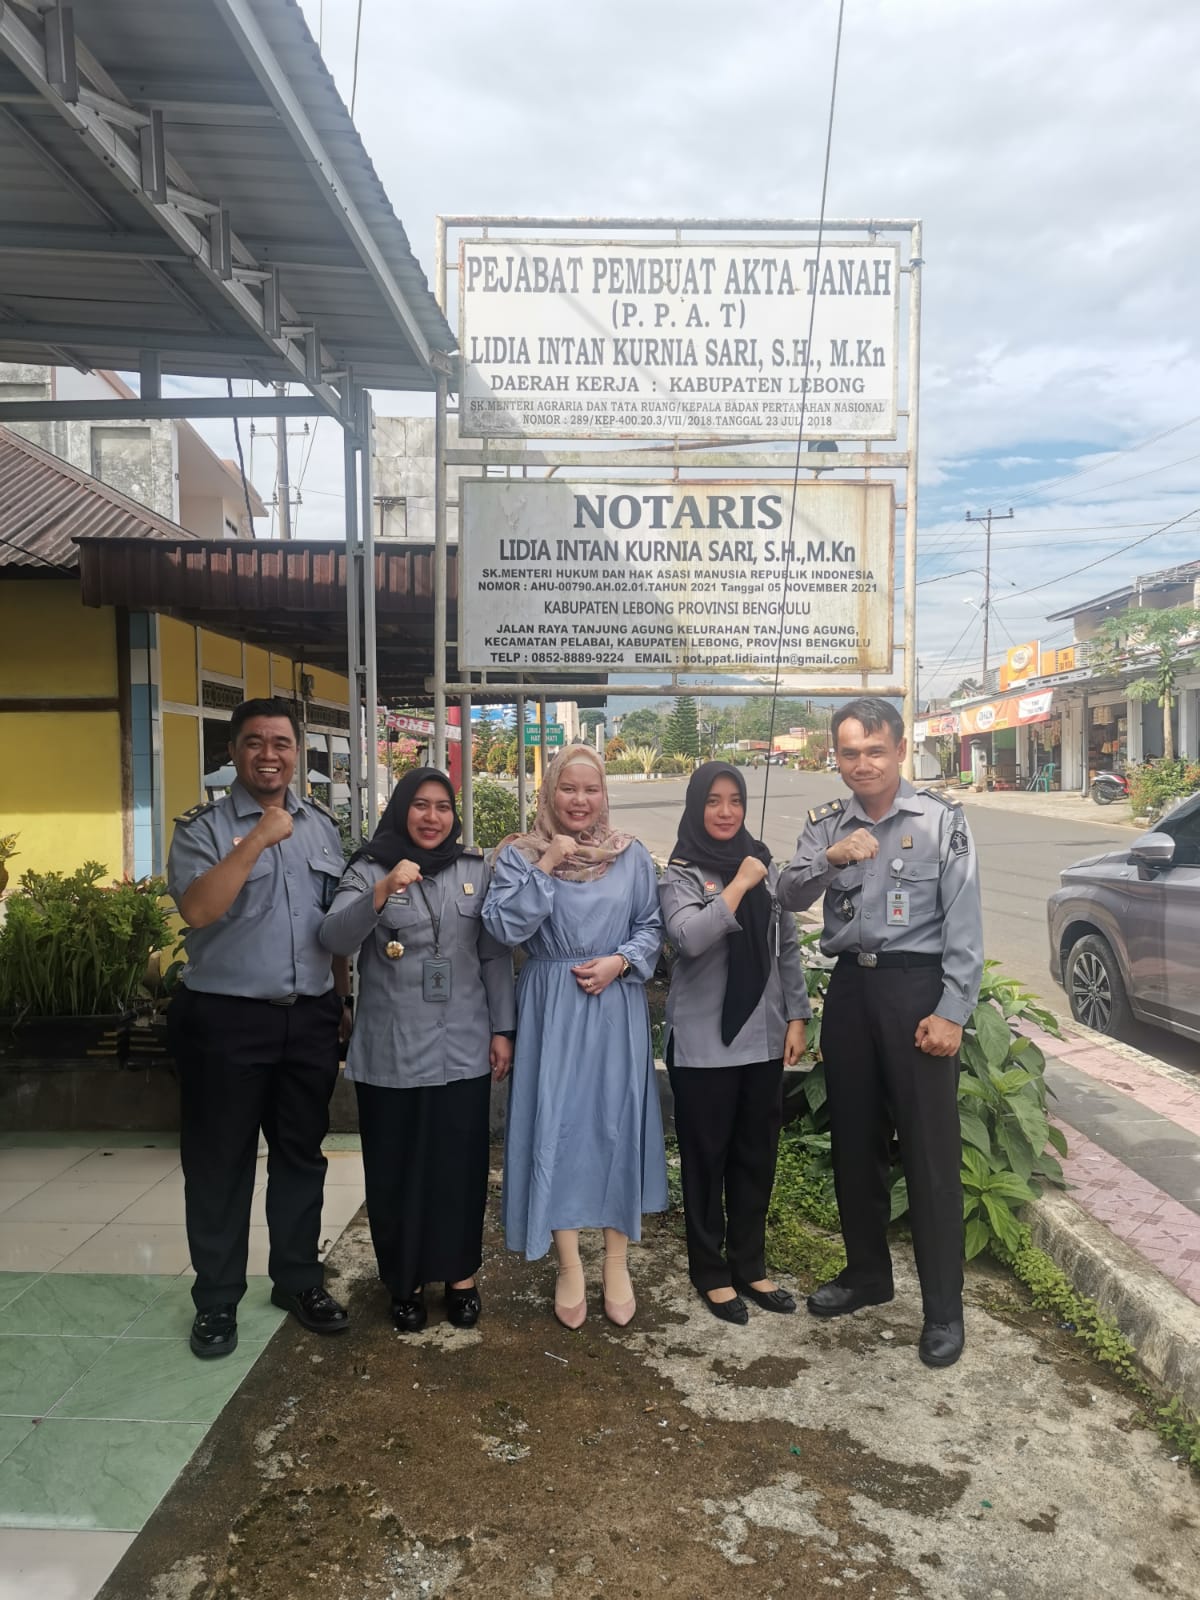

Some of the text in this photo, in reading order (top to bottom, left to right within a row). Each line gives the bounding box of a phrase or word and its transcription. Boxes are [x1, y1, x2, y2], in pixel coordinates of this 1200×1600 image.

[466, 256, 891, 296] PEJABAT PEMBUAT AKTA TANAH
[470, 336, 886, 373] LIDIA INTAN KURNIA SARI, S.H., M.Kn
[490, 375, 570, 391] DAERAH
[576, 376, 640, 392] KERJA
[669, 377, 782, 393] KABUPATEN
[789, 377, 866, 393] LEBONG
[470, 400, 885, 413] SK.MENTERI AGRARIA DAN TATA RUANG/KEPALA BADAN PERTANAHAN NASIONAL
[523, 414, 560, 425] NOMOR
[766, 416, 779, 426] 23
[781, 416, 804, 426] JUL
[807, 416, 832, 426] 2018
[573, 495, 783, 529] NOTARIS
[499, 539, 551, 560] LIDIA
[556, 540, 618, 561] INTAN
[625, 540, 703, 562] KURNIA
[708, 540, 757, 565] SARI,
[482, 568, 874, 580] SK.MENTERI HUKUM DAN HAK ASASI MANUSIA REPUBLIK INDONESIA
[478, 582, 520, 591] NOMOR
[691, 583, 717, 592] 2021
[721, 583, 764, 594] Tanggal
[768, 583, 781, 592] 05
[785, 583, 848, 593] NOVEMBER
[851, 583, 877, 593] 2021
[544, 601, 811, 615] KABUPATEN LEBONG PROVINSI BENGKULU
[496, 625, 859, 636] JALAN RAYA TANJUNG AGUNG KELURAHAN TANJUNG AGUNG,
[484, 637, 871, 649] KECAMATAN PELABAI, KABUPATEN LEBONG, PROVNSI BENGKULU
[490, 653, 520, 663] TELP
[531, 653, 624, 663] 0852-8889-9224
[635, 653, 672, 663] EMAIL
